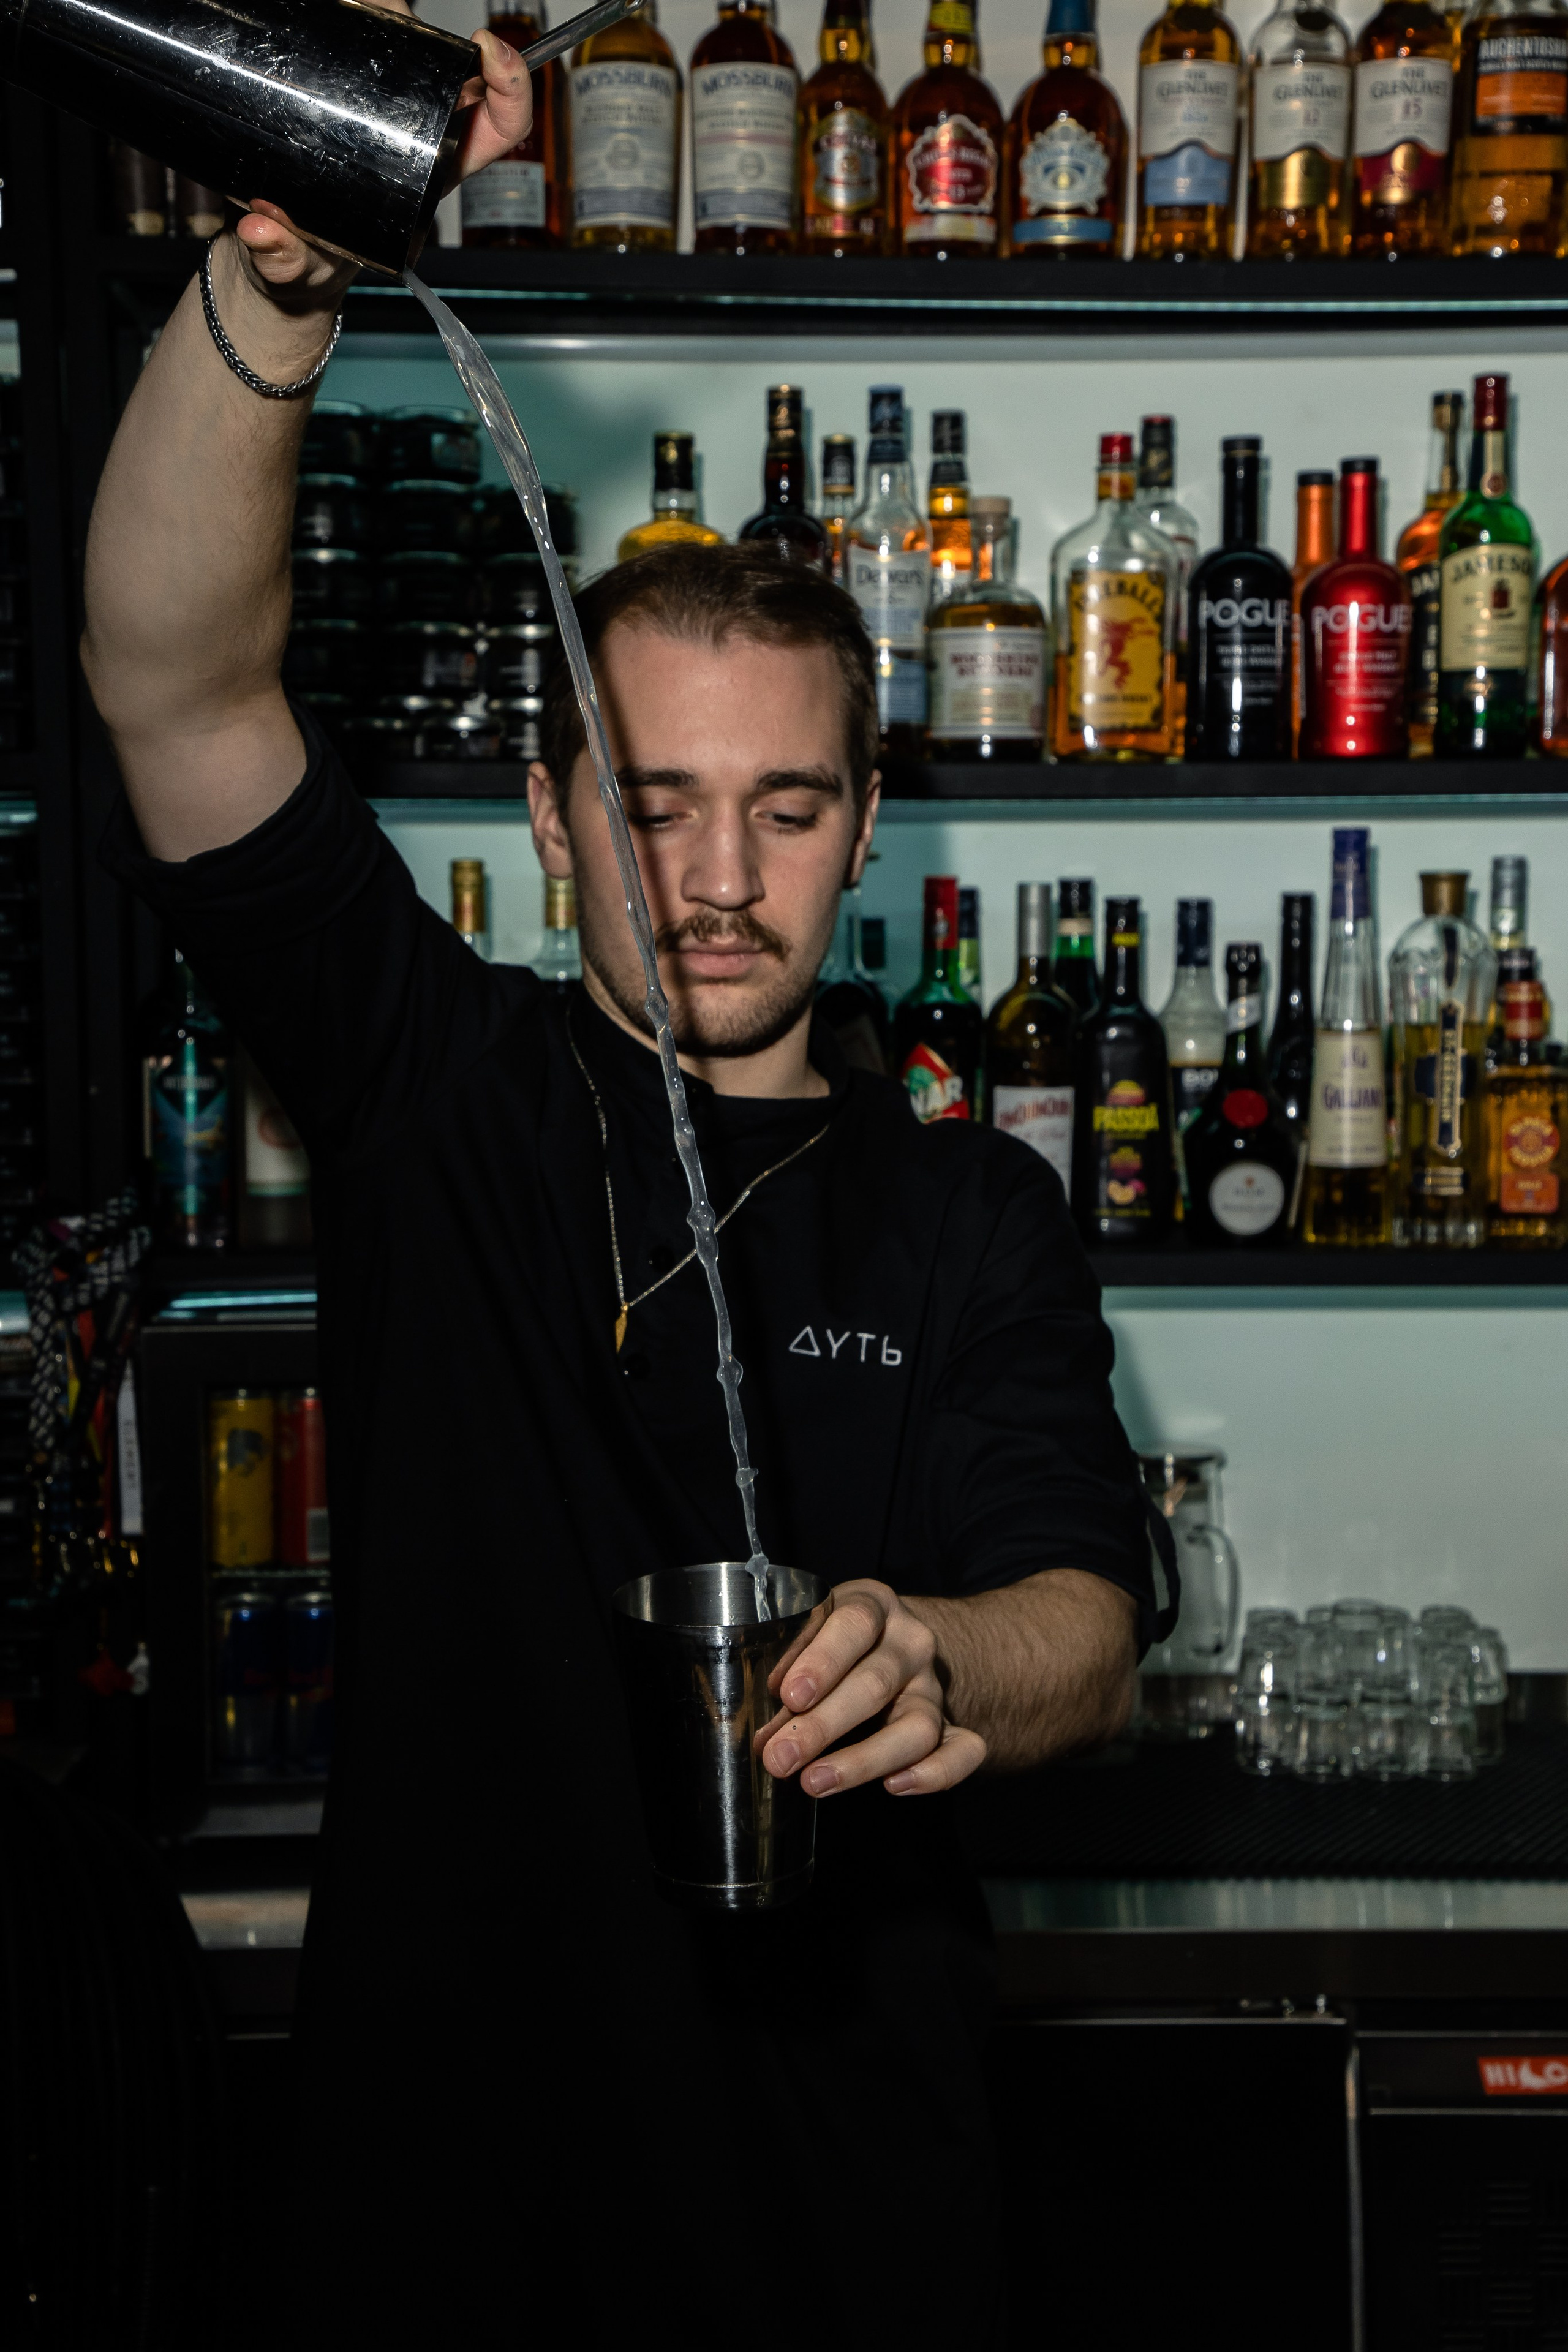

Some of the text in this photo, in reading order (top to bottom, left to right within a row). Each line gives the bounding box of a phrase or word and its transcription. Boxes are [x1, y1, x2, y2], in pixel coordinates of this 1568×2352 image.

[1157, 80, 1228, 97] GLENLIVET
[1273, 83, 1343, 102] GLENLIVET
[1370, 80, 1448, 99] GLENLIVET
